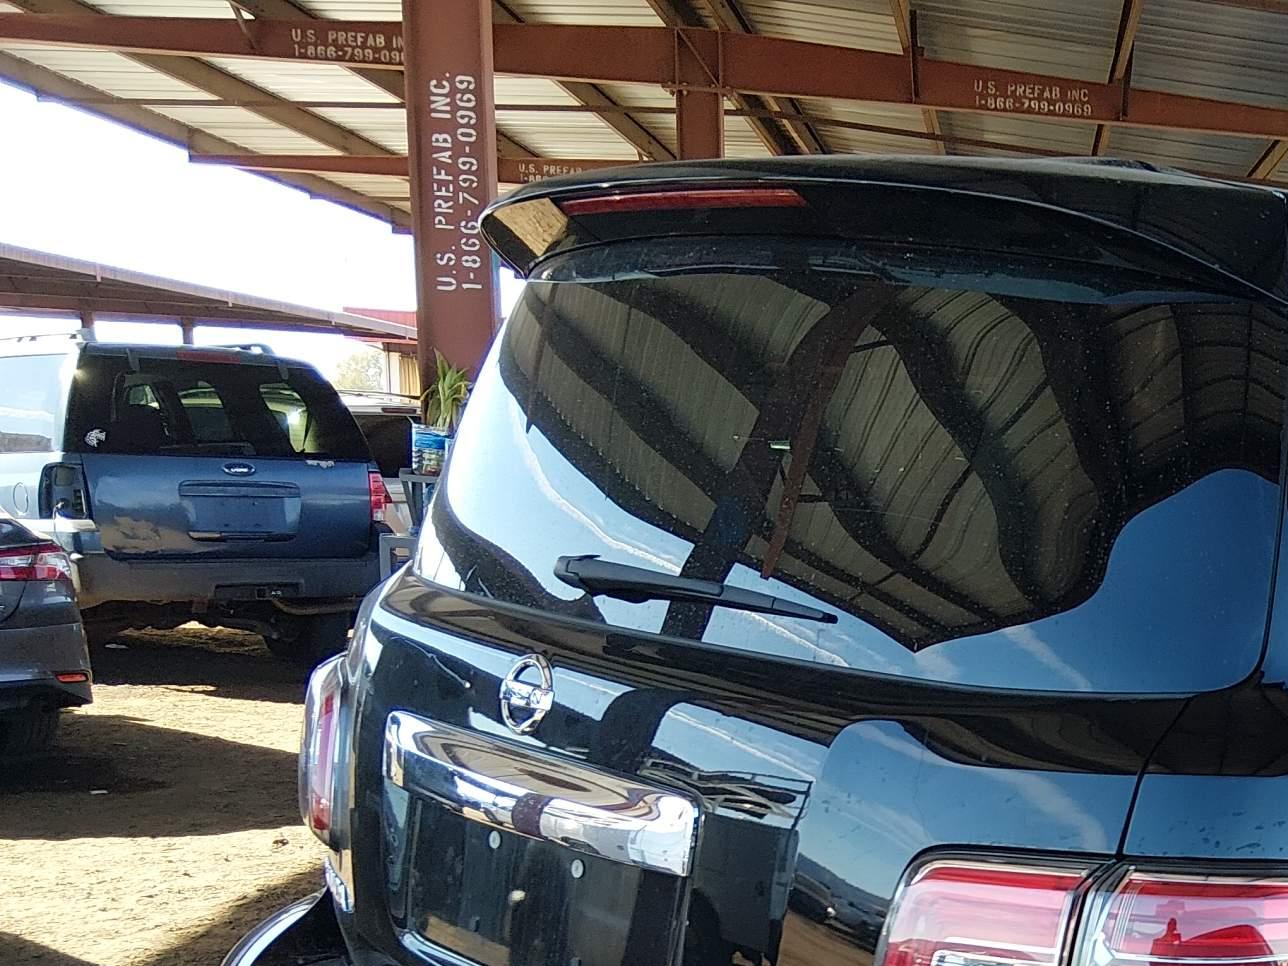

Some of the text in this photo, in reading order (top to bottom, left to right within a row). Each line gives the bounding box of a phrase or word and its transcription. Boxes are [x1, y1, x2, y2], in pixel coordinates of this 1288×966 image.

[327, 30, 385, 48] PREFAB
[974, 79, 1000, 96] U.S.
[1007, 83, 1060, 100] PREFAB
[975, 95, 1092, 116] 1-866-799-0969
[518, 162, 539, 174] U.S.
[429, 72, 457, 291] U.S. PREFAB INC.
[455, 75, 482, 290] 1-866-799-0969
